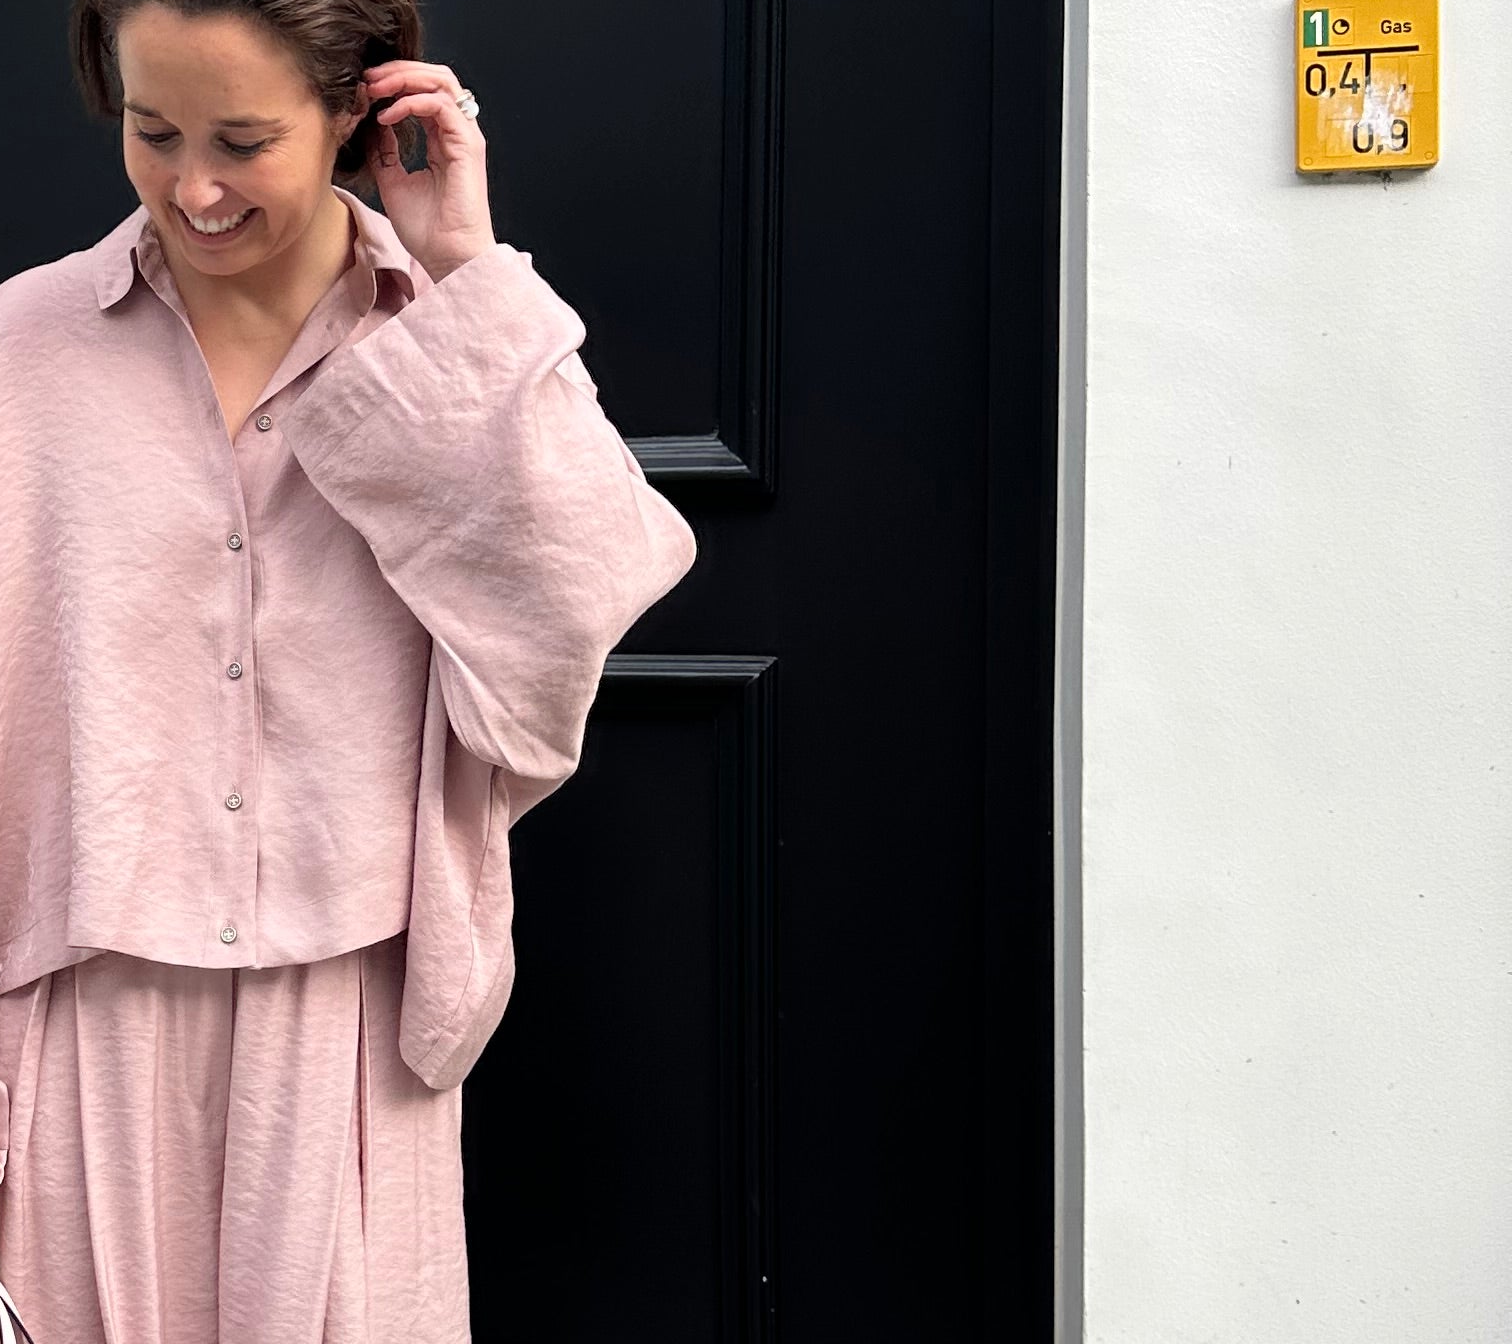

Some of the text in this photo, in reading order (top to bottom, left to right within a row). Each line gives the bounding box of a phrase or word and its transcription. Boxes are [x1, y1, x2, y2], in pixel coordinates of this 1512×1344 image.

[1309, 11, 1323, 46] 1
[1380, 19, 1413, 35] Gas
[1305, 61, 1361, 98] 0,4
[1352, 119, 1409, 155] 0,9
